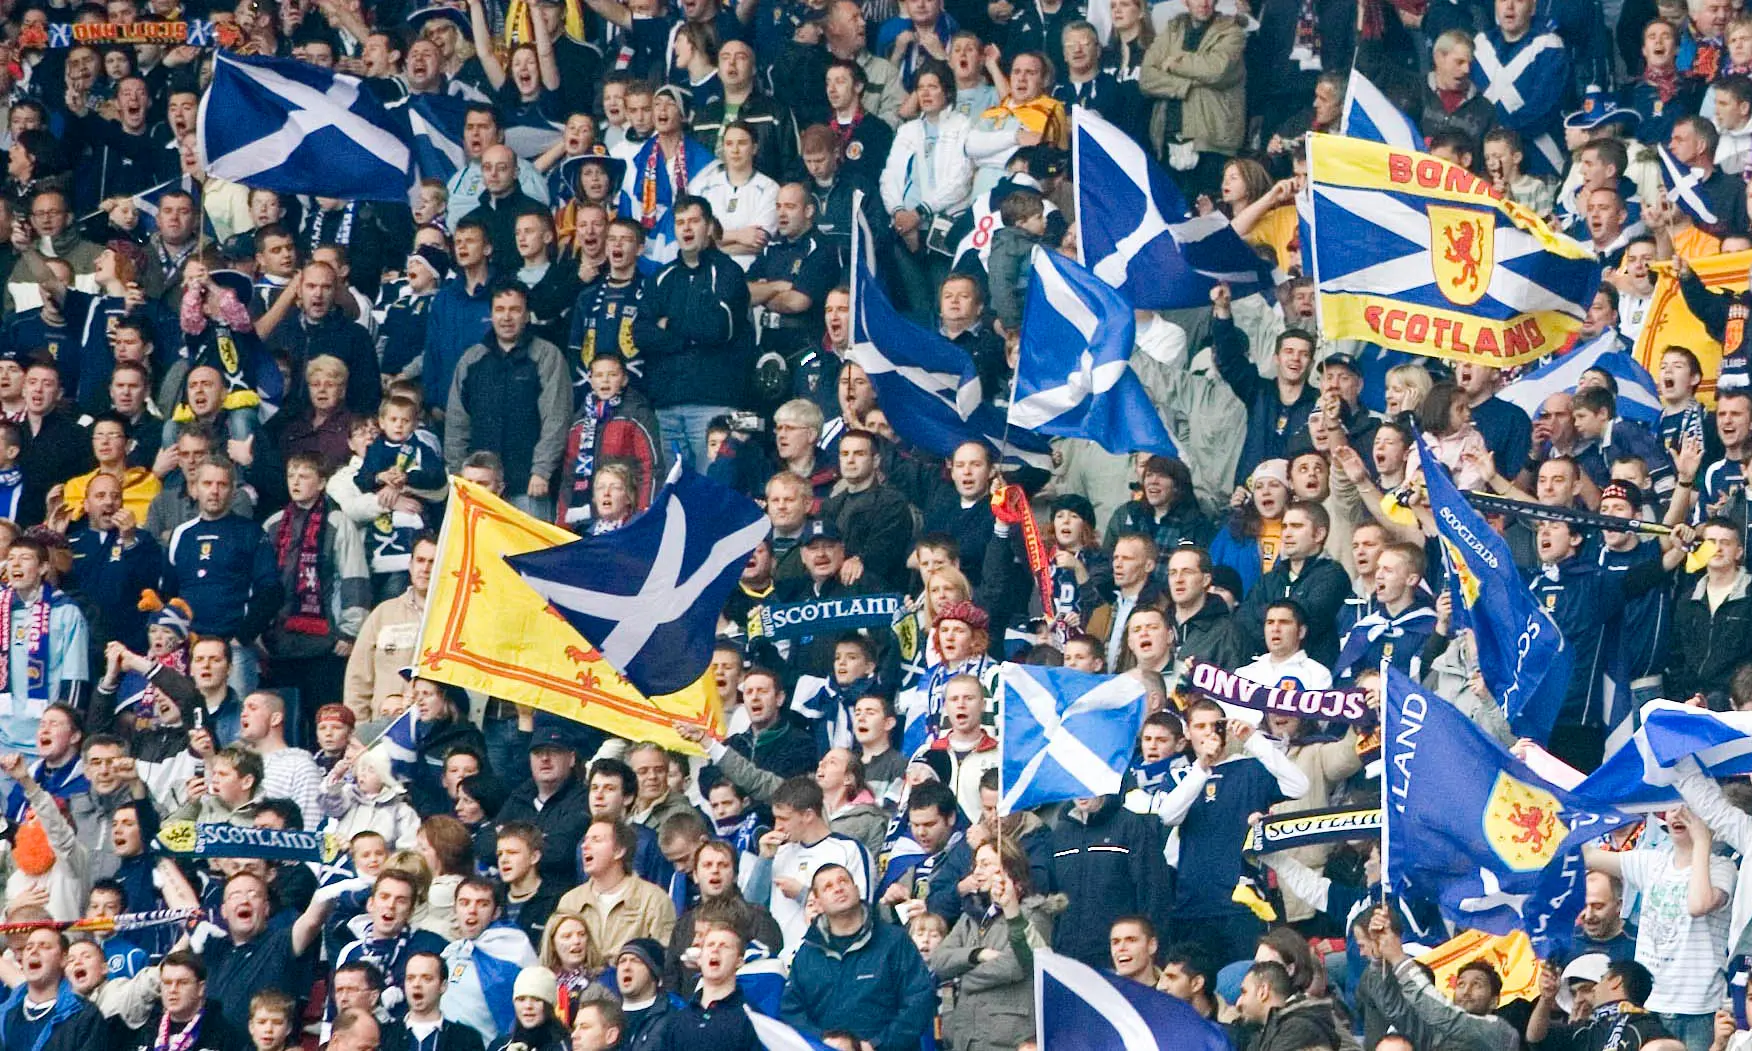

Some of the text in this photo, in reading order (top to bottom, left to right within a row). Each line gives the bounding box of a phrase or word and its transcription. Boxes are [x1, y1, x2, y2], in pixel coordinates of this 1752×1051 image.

[1388, 153, 1518, 210] BONN
[972, 215, 994, 248] 8
[1364, 305, 1546, 358] SCOTLAND
[772, 597, 898, 629] SCOTLAND
[1192, 662, 1365, 719] SCOTLAND
[1392, 692, 1428, 813] LAND
[204, 825, 316, 850] SCOTLAND
[1270, 813, 1382, 838] SCOTLAN
